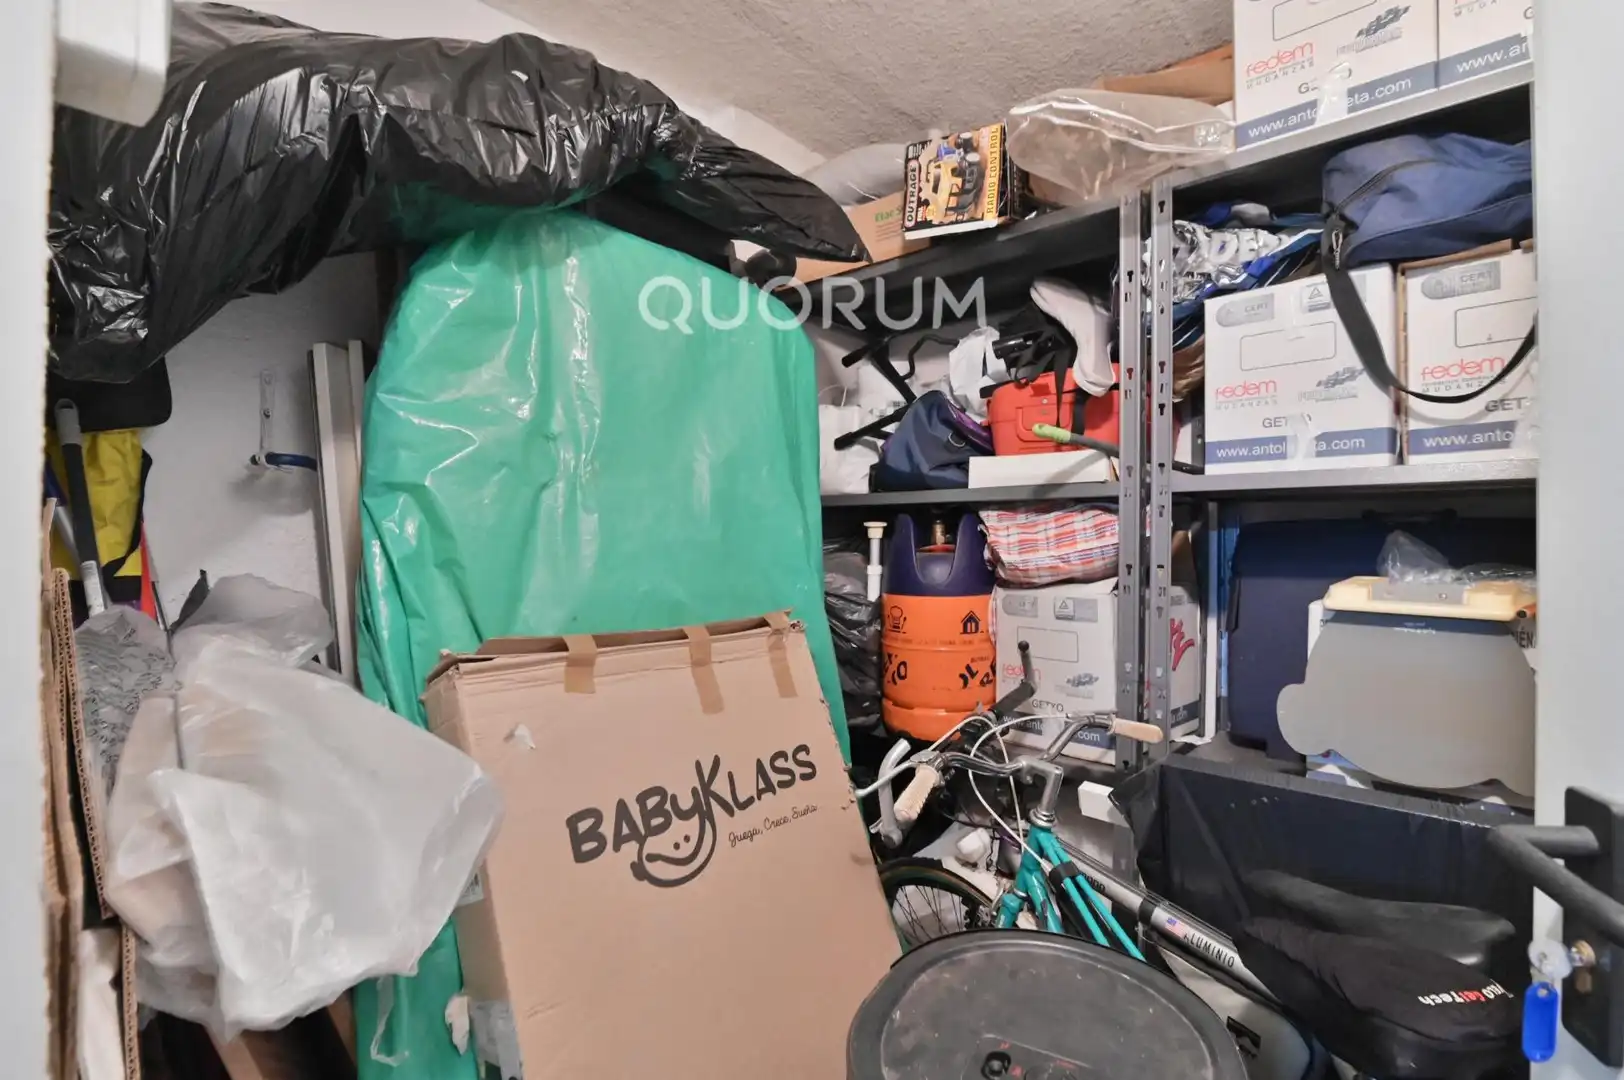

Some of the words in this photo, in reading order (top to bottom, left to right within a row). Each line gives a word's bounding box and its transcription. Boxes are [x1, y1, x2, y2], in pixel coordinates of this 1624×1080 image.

[1245, 42, 1314, 77] fedem
[989, 126, 999, 177] CONTROL
[906, 166, 917, 222] OUTRAGE
[986, 181, 996, 214] RADIO
[1421, 357, 1505, 380] fedem
[1215, 379, 1278, 399] fedem
[1484, 396, 1528, 412] GET
[1183, 932, 1235, 968] ALUMINIO
